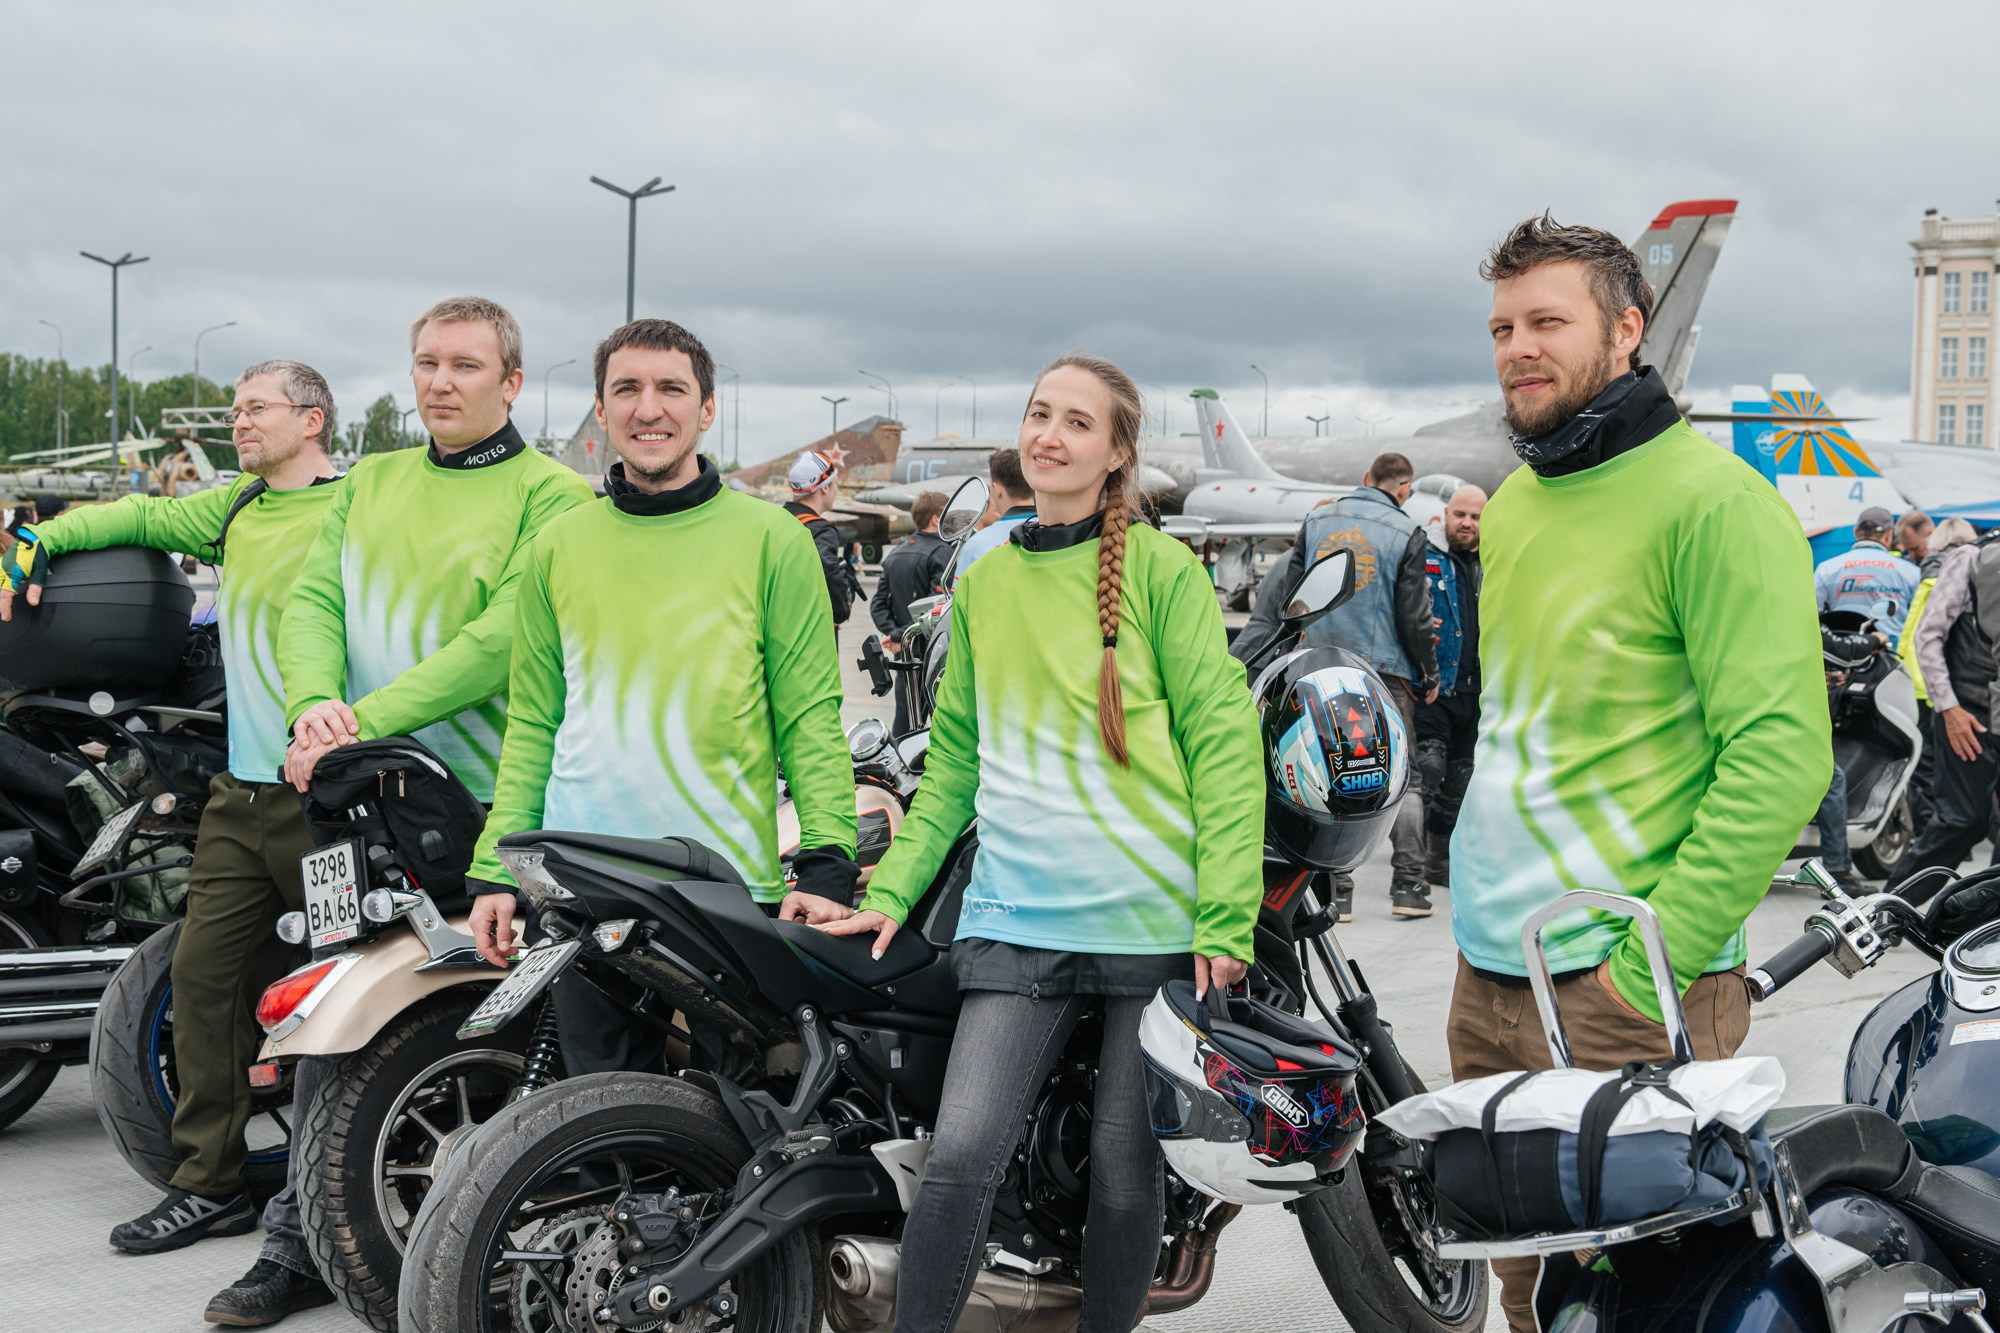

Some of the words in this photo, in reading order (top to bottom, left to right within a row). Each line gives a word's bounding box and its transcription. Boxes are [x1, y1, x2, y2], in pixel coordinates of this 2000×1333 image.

[1648, 243, 1674, 265] 05
[463, 443, 507, 466] MOTEQ
[1848, 481, 1864, 503] 4
[1341, 771, 1383, 791] SHOEI
[309, 851, 347, 887] 3298
[332, 883, 345, 897] RUS
[513, 948, 562, 978] 2122
[1264, 1087, 1305, 1125] SHOEI
